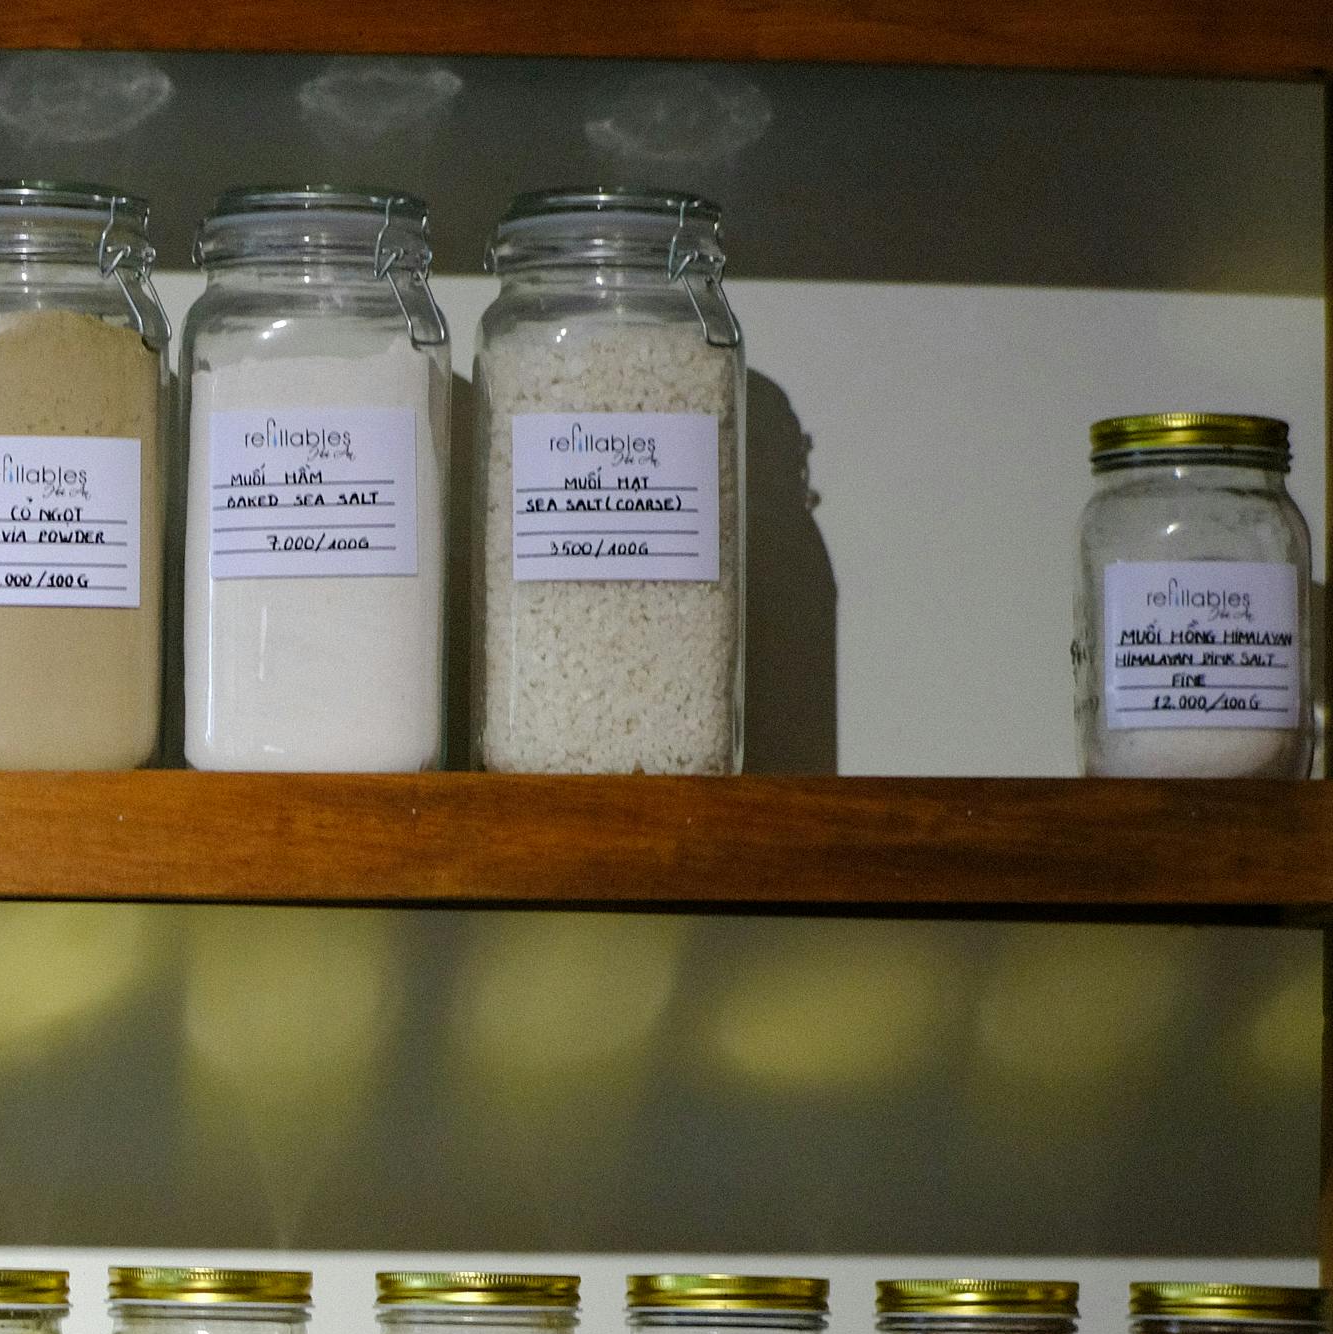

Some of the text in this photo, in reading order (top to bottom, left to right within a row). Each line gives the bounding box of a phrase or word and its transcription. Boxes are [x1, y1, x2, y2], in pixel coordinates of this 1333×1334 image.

[245, 418, 350, 448] refillables
[550, 424, 655, 453] refillables
[228, 492, 378, 508] BAKED SEA SALT
[527, 499, 557, 511] SEA
[39, 530, 105, 543] POWDER
[1147, 578, 1250, 608] refillables
[1241, 654, 1274, 667] SALT
